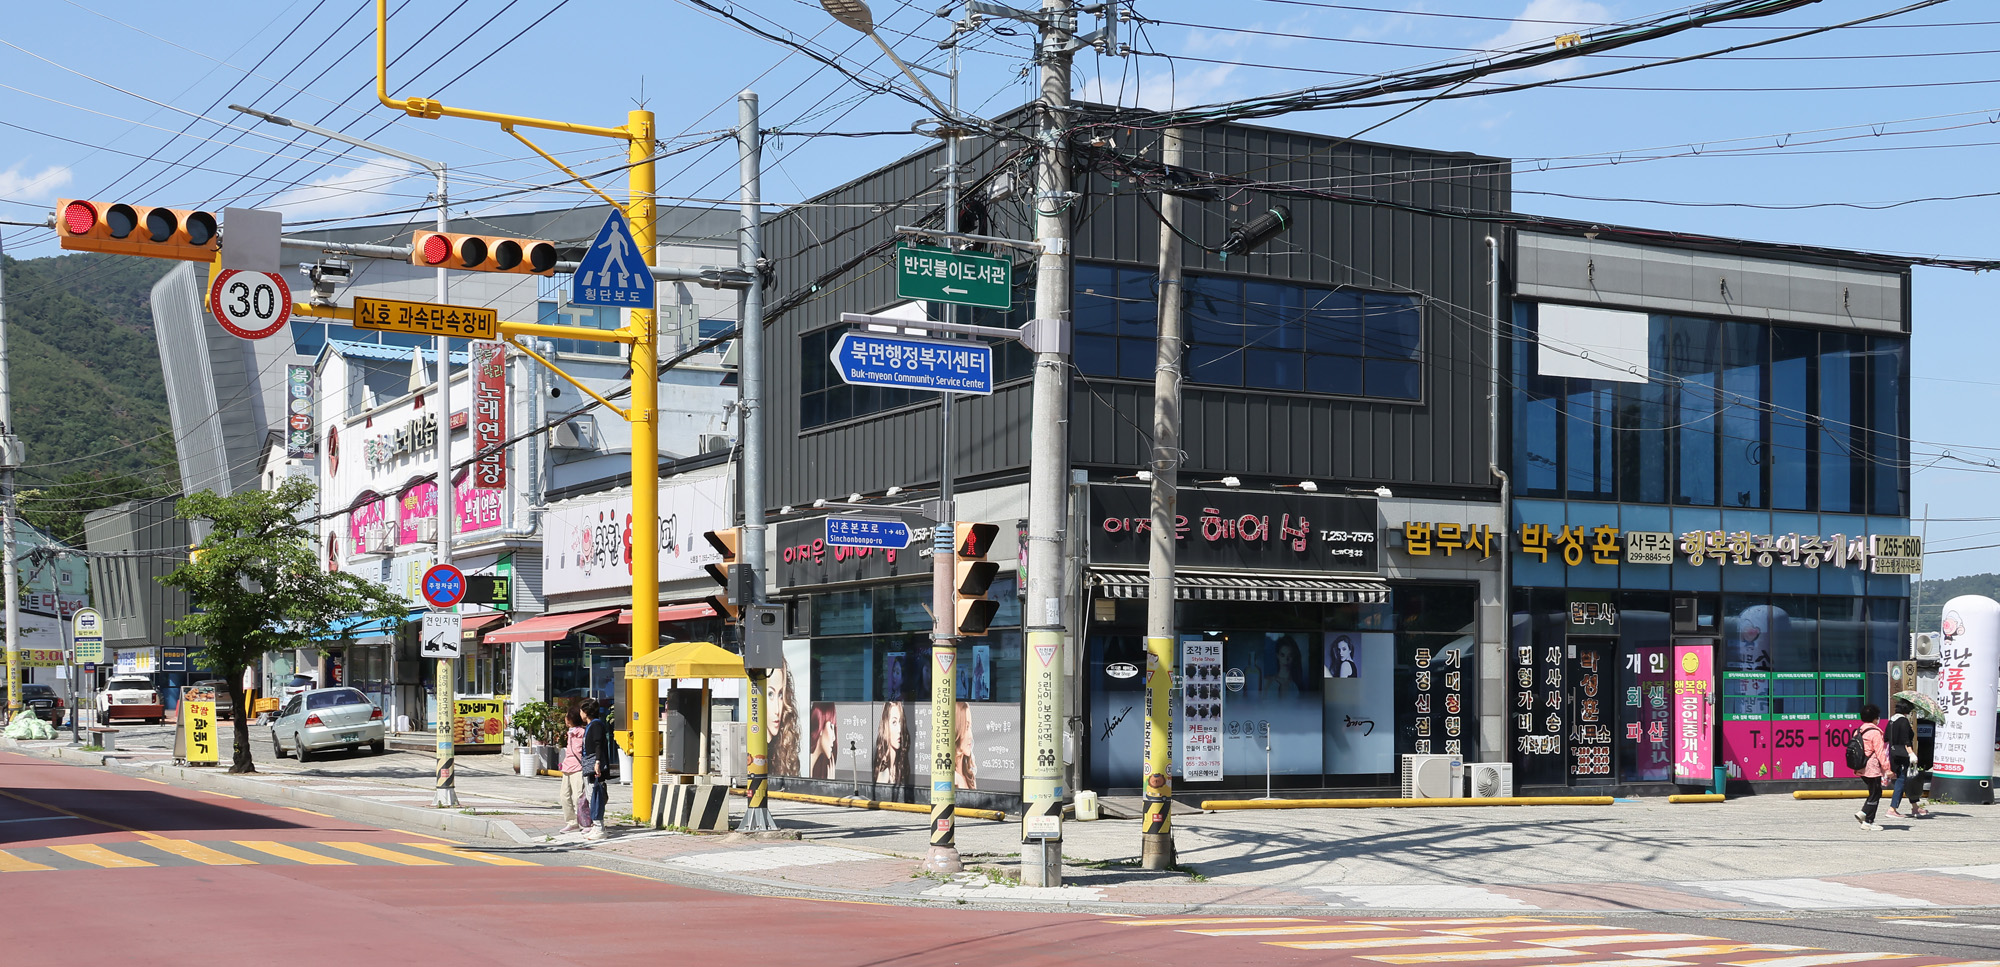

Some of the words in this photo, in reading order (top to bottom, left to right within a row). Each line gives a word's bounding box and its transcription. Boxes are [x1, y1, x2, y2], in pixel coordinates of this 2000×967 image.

[904, 256, 1006, 285] 반딧불이도서관
[228, 281, 275, 319] 30
[584, 288, 641, 302] 횡단보도
[360, 302, 392, 326] 신호
[398, 307, 492, 336] 과속단속장비
[851, 341, 985, 374] 북면행정복지센터
[851, 368, 893, 381] Buk-myeon
[894, 372, 934, 385] Community
[936, 375, 960, 387] Service
[962, 378, 985, 389] Center
[393, 410, 438, 455] 노래연습
[478, 382, 502, 484] 노래연습장
[830, 521, 880, 534] 신촌본포로
[830, 535, 883, 545] Sinchonbonpo-ro
[1200, 507, 1269, 541] 헤어
[1281, 513, 1310, 551] 샵
[1320, 530, 1374, 543] T.253-7575
[1403, 521, 1493, 558] 법무사
[783, 538, 826, 564] 이지은
[1520, 523, 1620, 566] 박성훈
[1630, 534, 1671, 551] 사무소
[1875, 537, 1921, 557] T.255-1600
[1630, 552, 1671, 562] 299-8845~6
[425, 616, 459, 626] 견인지역
[1571, 602, 1615, 624] 법무사
[1187, 646, 1202, 655] 조각
[1205, 646, 1220, 655] 커트
[942, 678, 950, 705] 어린이
[1043, 671, 1051, 700] 어린이
[1580, 650, 1600, 721] 박성훈
[1674, 680, 1707, 694] 행복한
[191, 704, 209, 716] 찹쌀
[941, 710, 950, 747] 보호구역
[1043, 705, 1051, 743] 보호구역
[1101, 707, 1133, 741] Hair
[1189, 724, 1218, 733] 커트만으로
[1569, 724, 1611, 744] 사무소
[1682, 697, 1699, 765] 공인중개사
[1750, 730, 1766, 748] T.
[1775, 730, 1804, 748] 255
